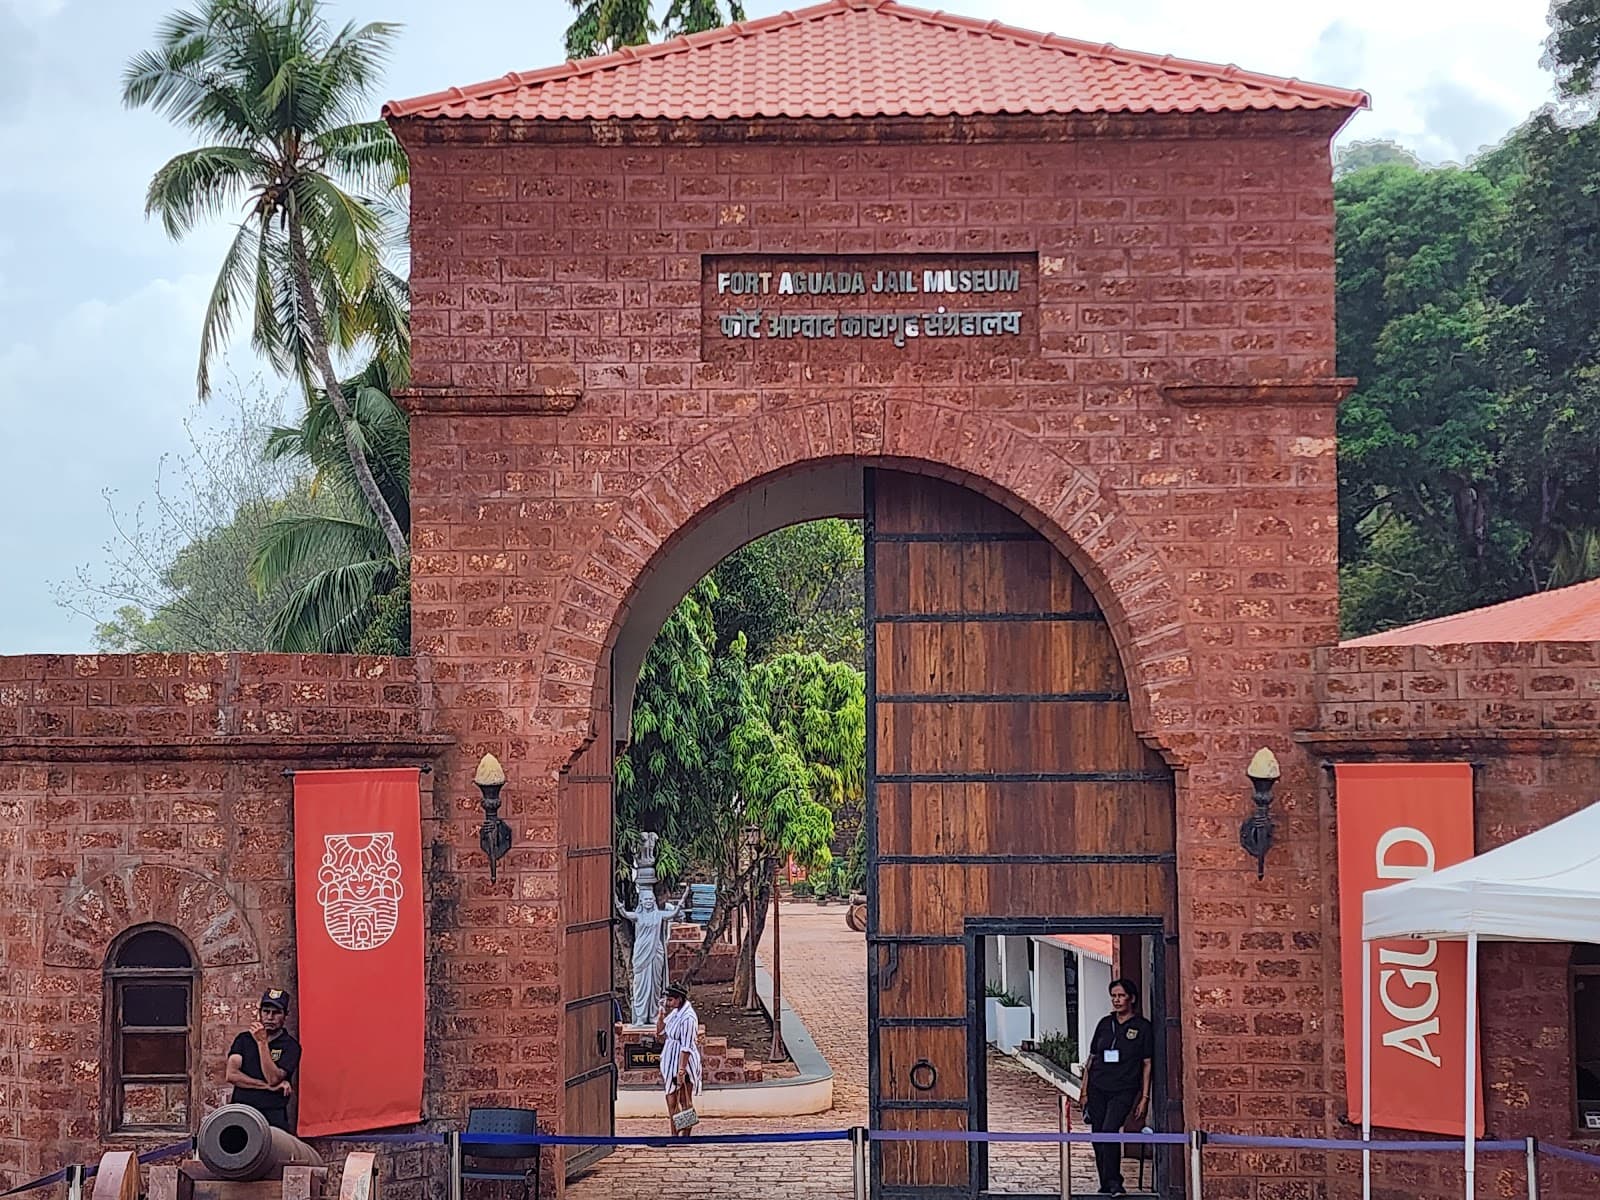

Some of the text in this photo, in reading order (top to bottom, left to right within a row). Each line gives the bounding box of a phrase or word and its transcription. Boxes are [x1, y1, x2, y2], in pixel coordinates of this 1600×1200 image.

[717, 269, 1020, 295] FORT AGUADA JAIL MUSEUM
[719, 308, 762, 338] फोर्ट
[840, 312, 919, 347] कारागृह
[922, 306, 1022, 336] संग्रहालय
